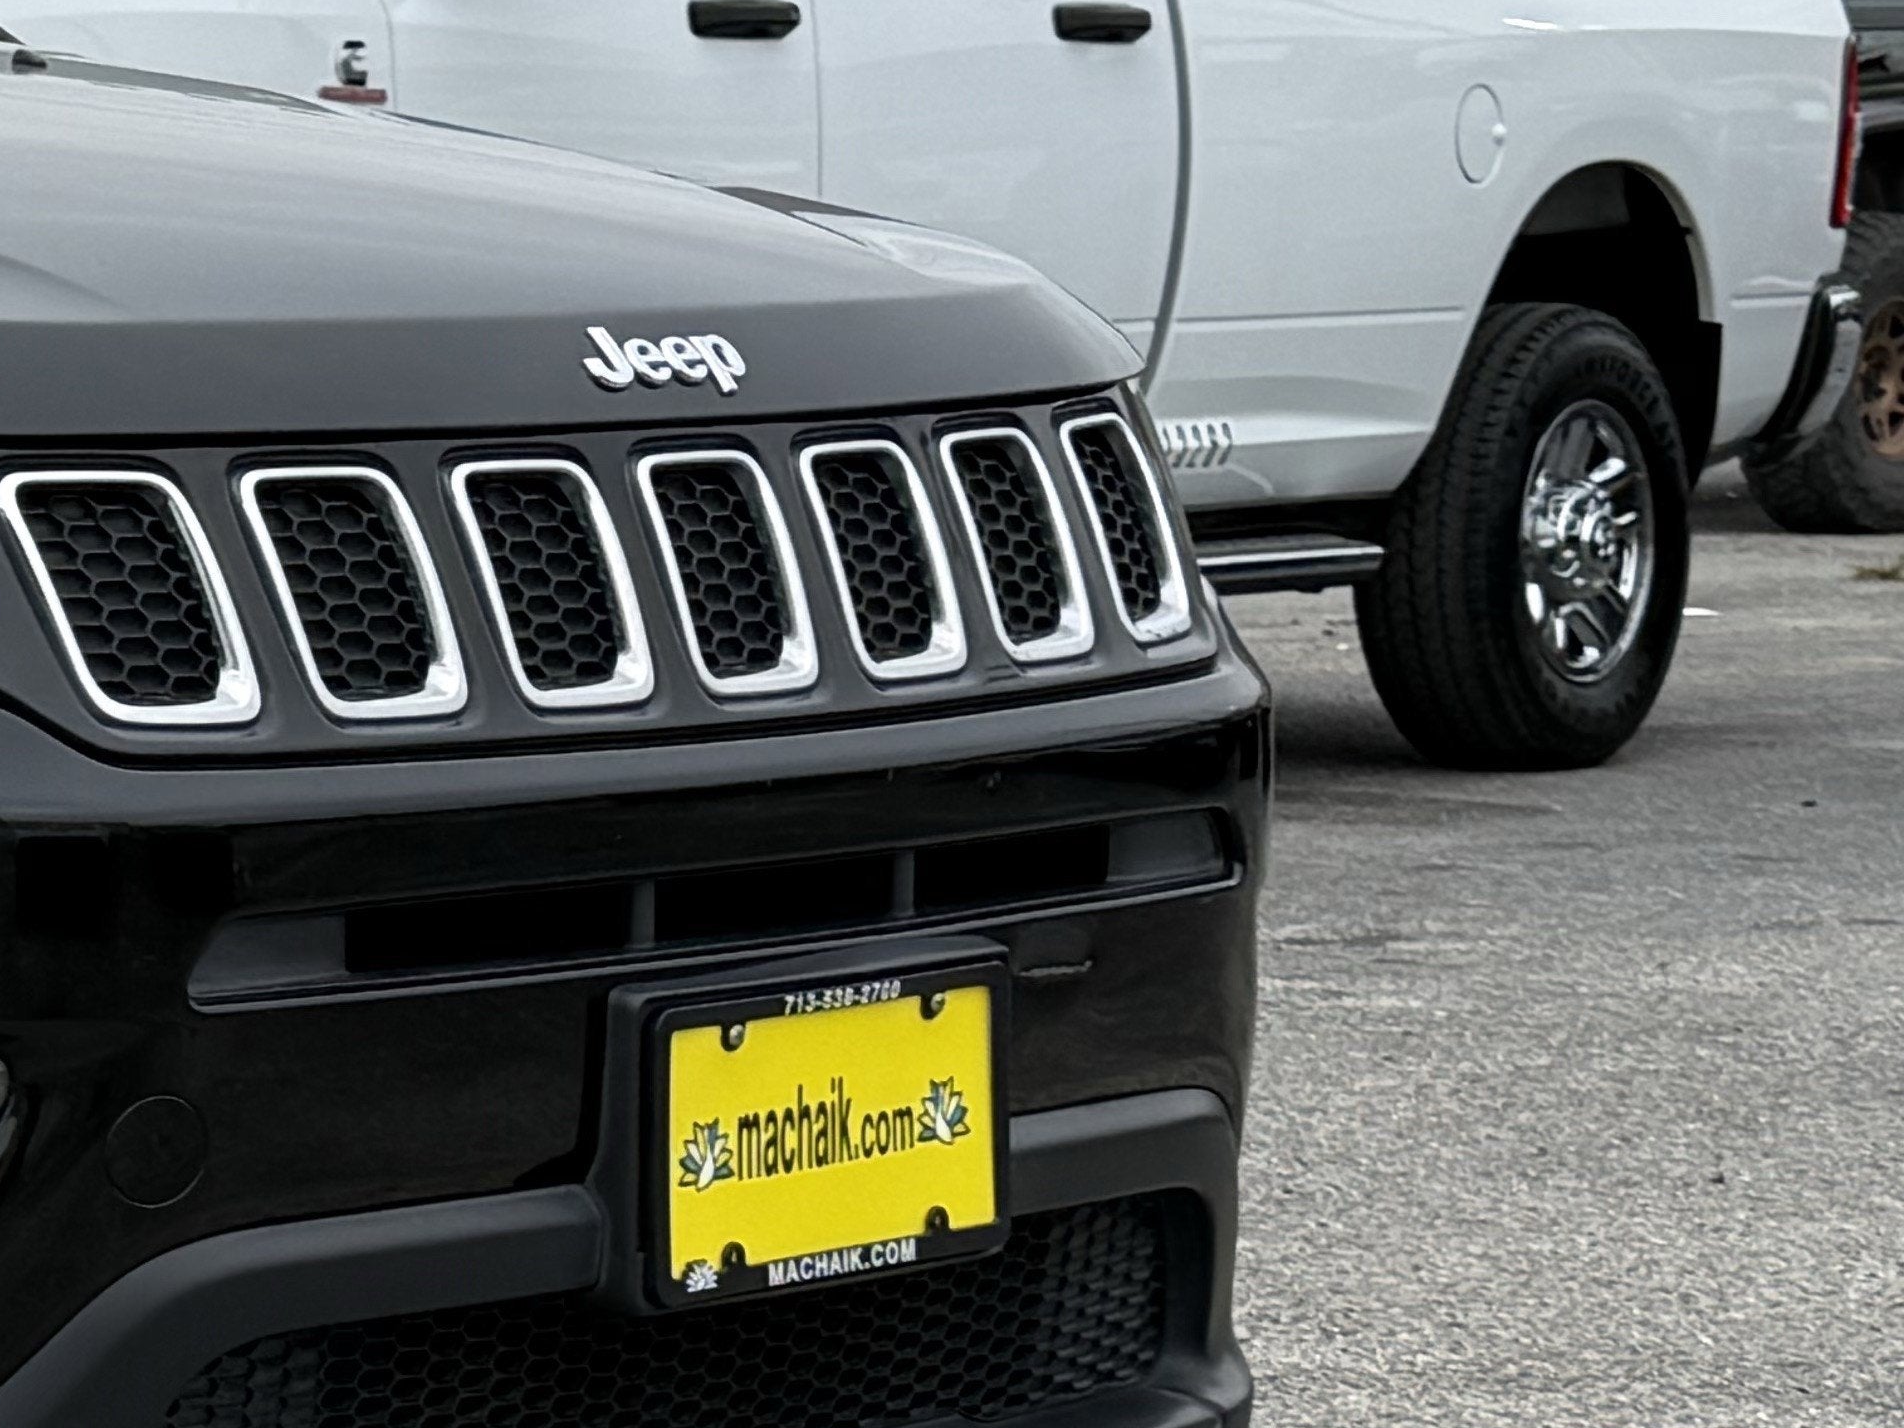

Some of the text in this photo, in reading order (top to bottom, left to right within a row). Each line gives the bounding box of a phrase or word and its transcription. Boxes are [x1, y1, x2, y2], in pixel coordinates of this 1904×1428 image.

[582, 326, 747, 394] Jeep
[737, 1076, 916, 1182] machaik.com
[768, 1239, 916, 1287] MACHAIK.COM
